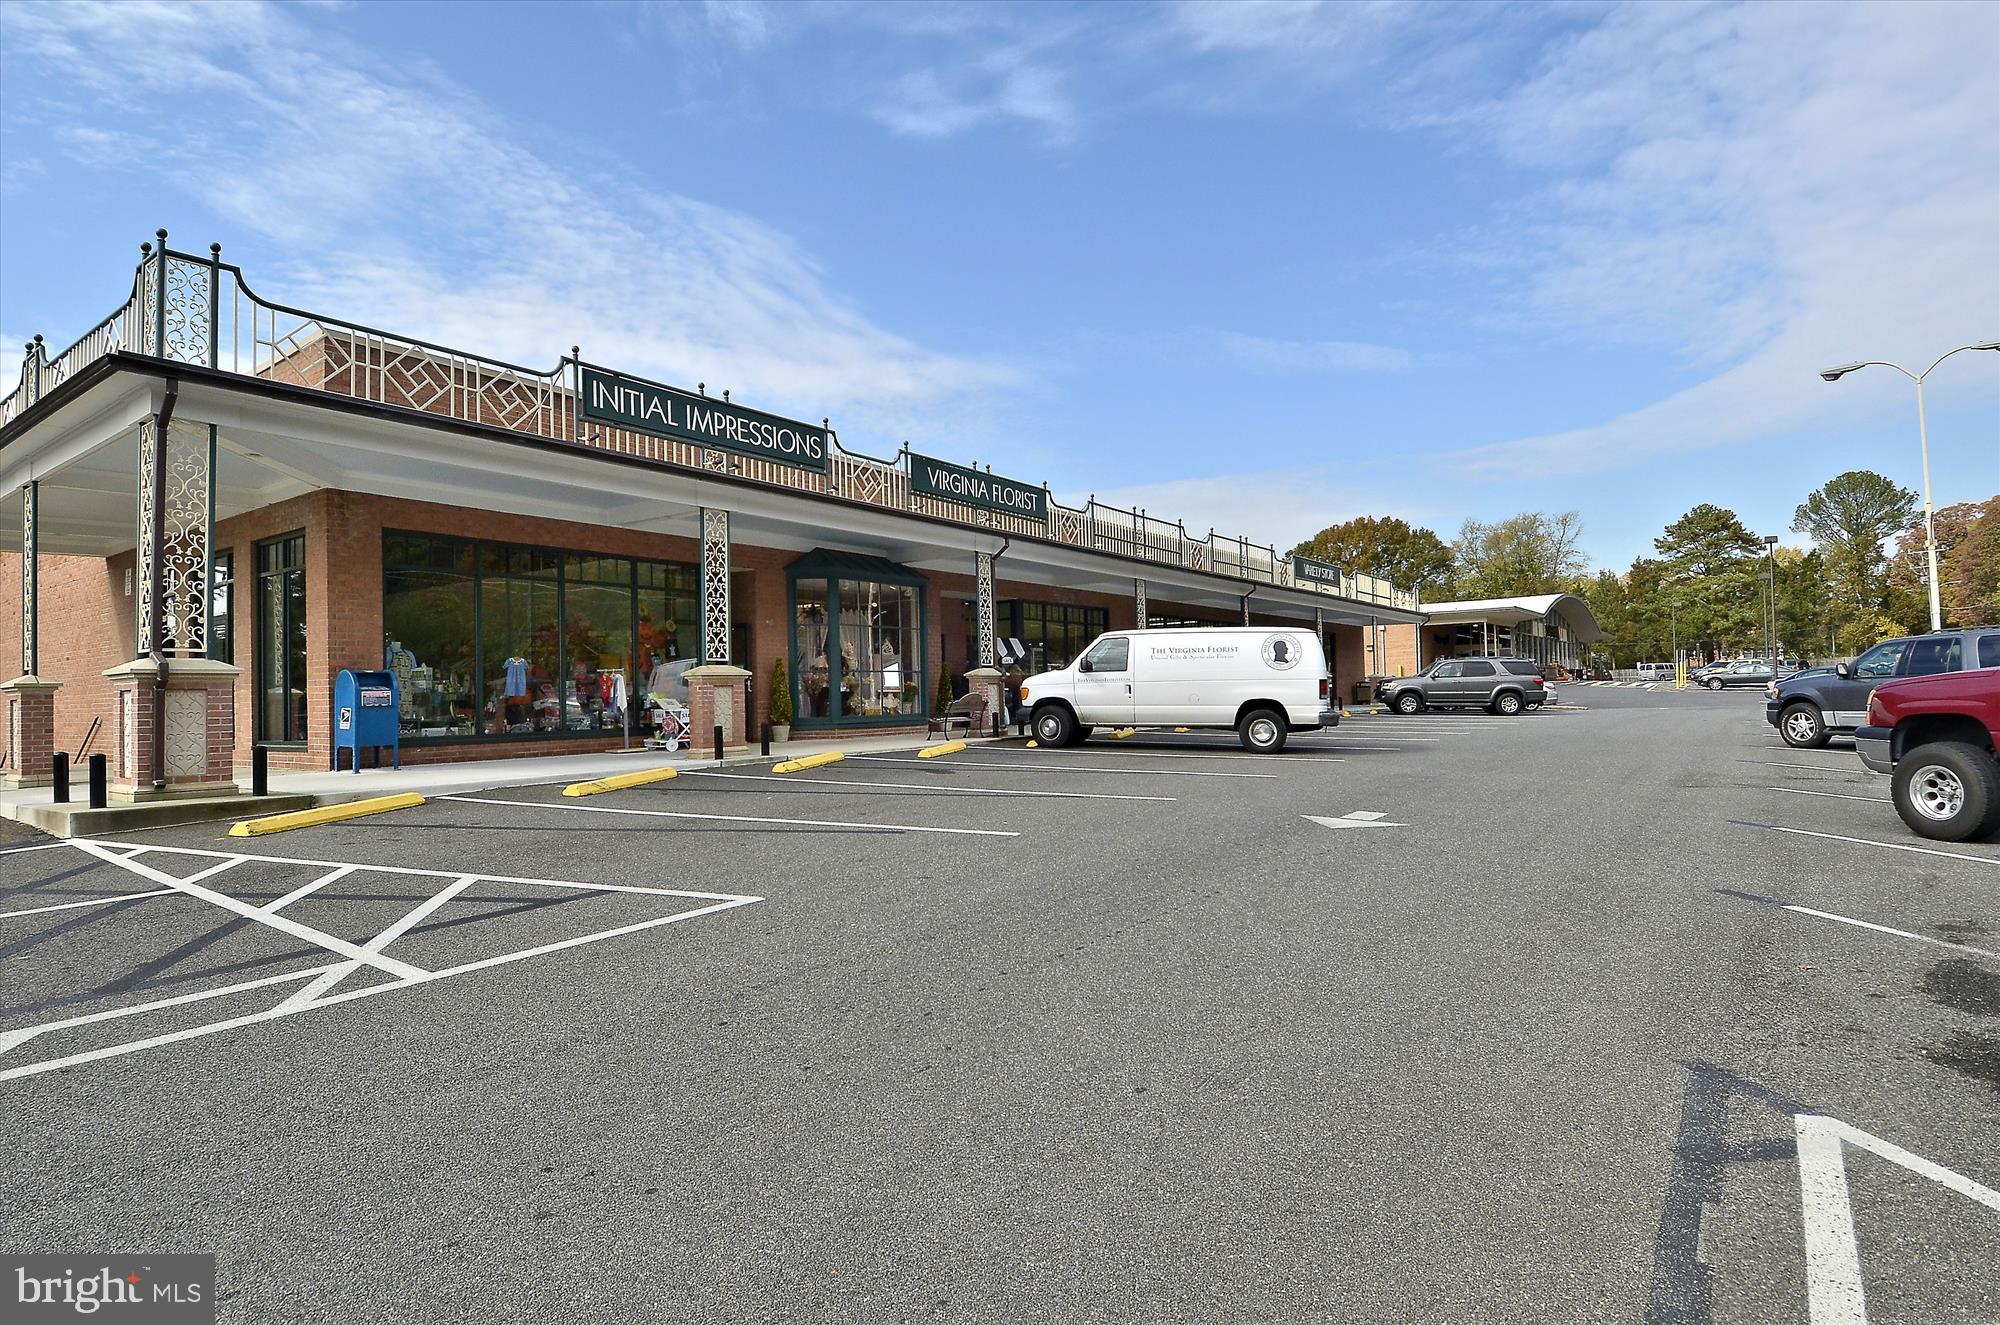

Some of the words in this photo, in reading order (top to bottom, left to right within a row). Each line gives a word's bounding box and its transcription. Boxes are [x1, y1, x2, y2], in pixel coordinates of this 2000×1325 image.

[592, 380, 679, 426] INITIAL
[686, 404, 822, 459] IMPRESSIONS
[927, 466, 990, 500] VIRGINIA
[992, 484, 1038, 511] FLORIST
[1168, 646, 1205, 654] VIRGINIA
[1207, 645, 1239, 653] FLORIST
